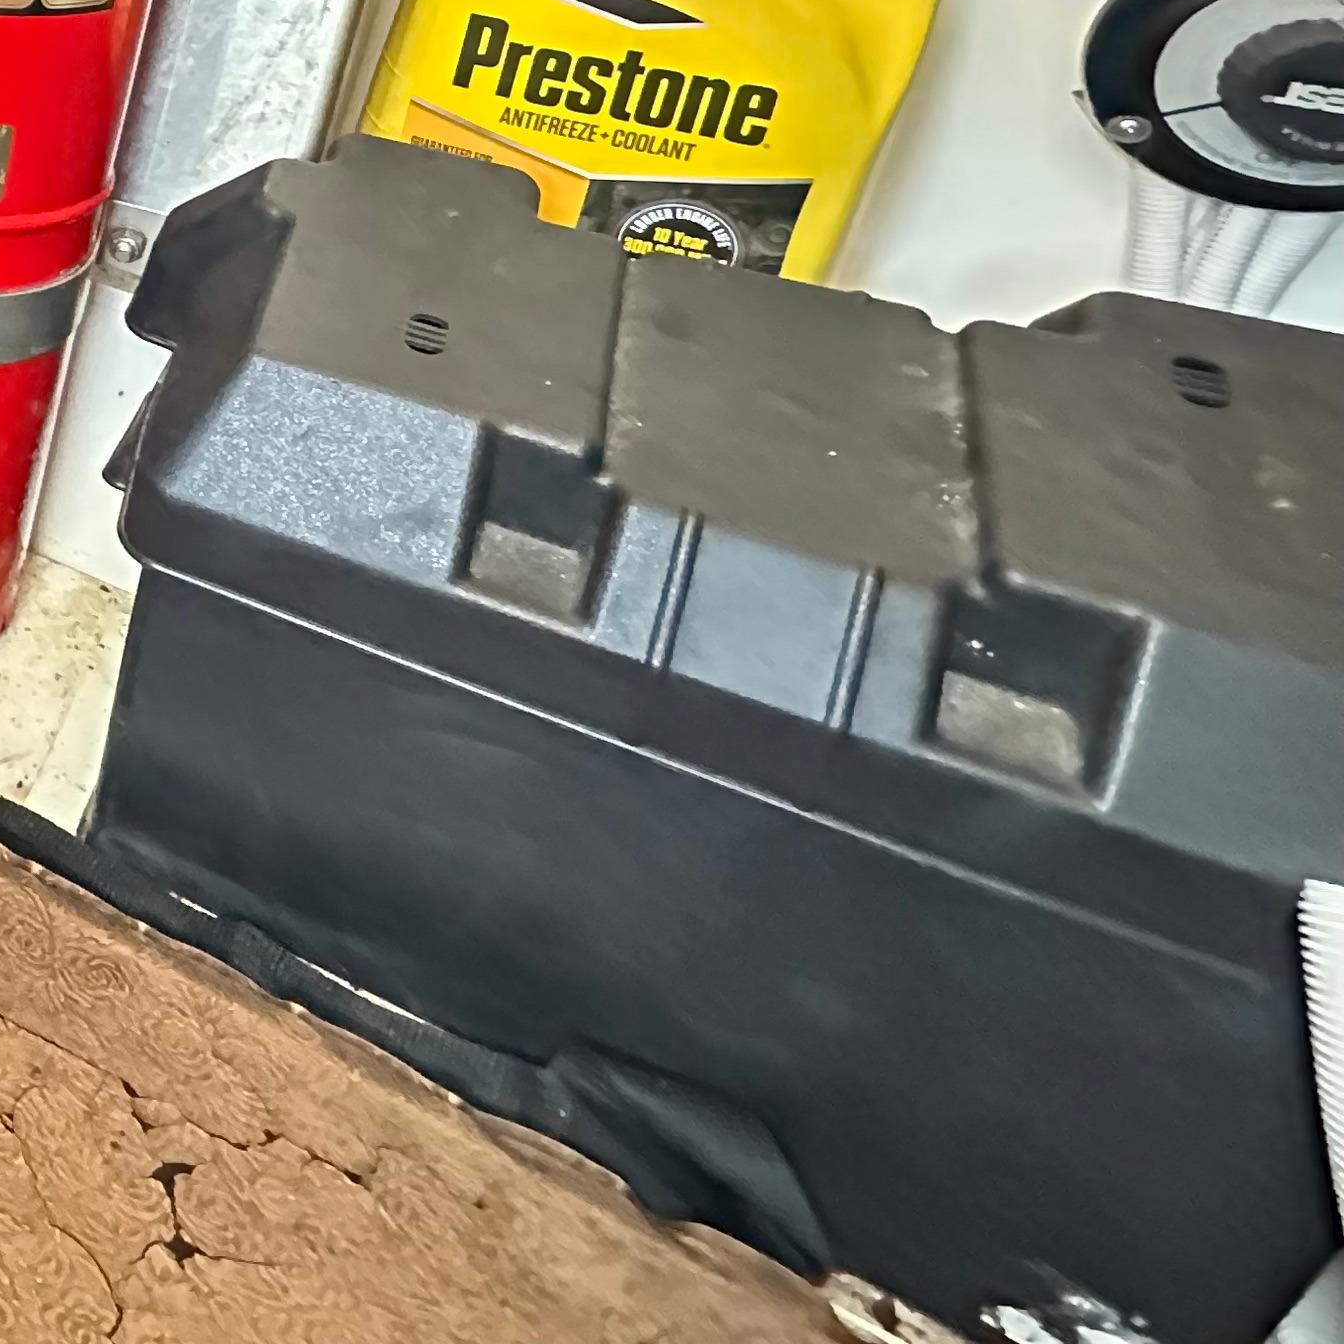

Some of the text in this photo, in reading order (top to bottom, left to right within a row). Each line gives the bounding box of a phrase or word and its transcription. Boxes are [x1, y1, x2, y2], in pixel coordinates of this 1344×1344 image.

[452, 12, 779, 148] Prestone
[676, 208, 720, 231] ENGINE
[654, 227, 708, 250] 10 Year
